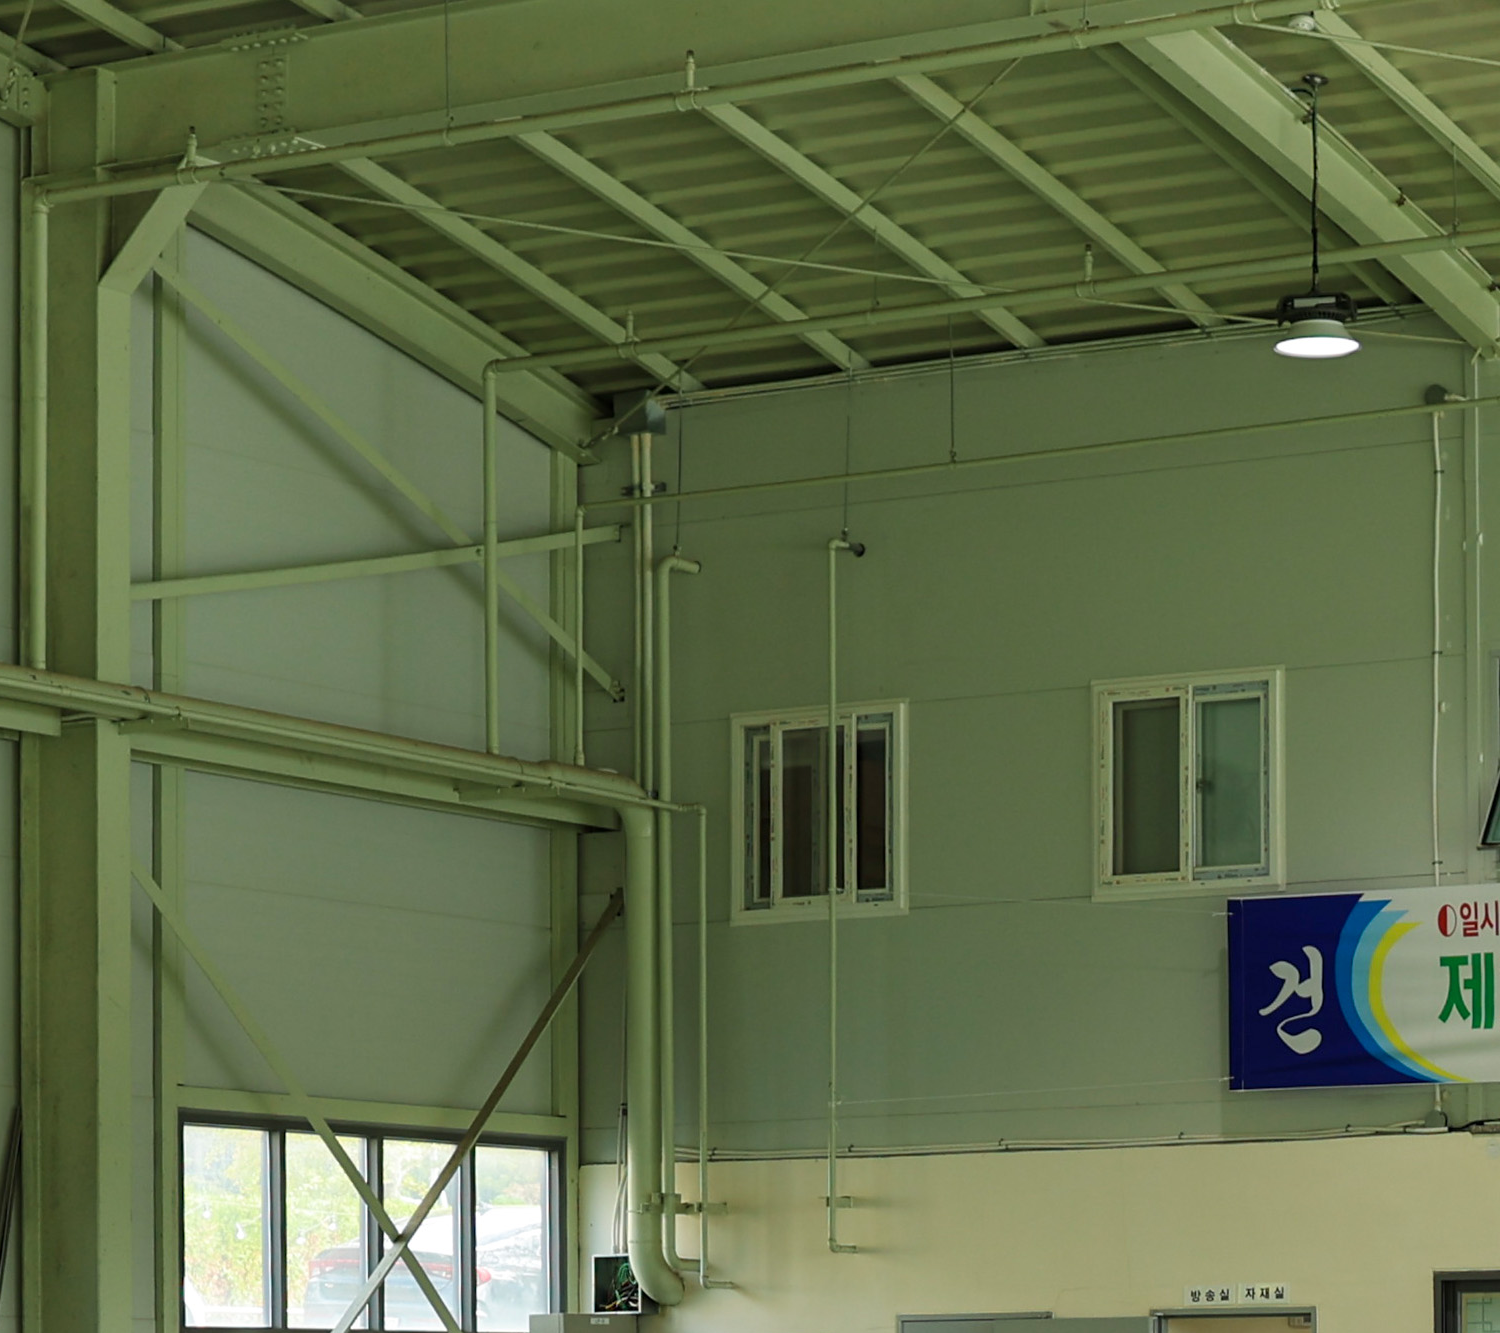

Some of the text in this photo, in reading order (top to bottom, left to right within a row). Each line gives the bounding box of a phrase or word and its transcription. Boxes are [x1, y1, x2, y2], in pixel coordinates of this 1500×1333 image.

[1460, 900, 1499, 937] 일시
[1258, 944, 1324, 1055] 건
[1245, 1286, 1285, 1300] 자재실
